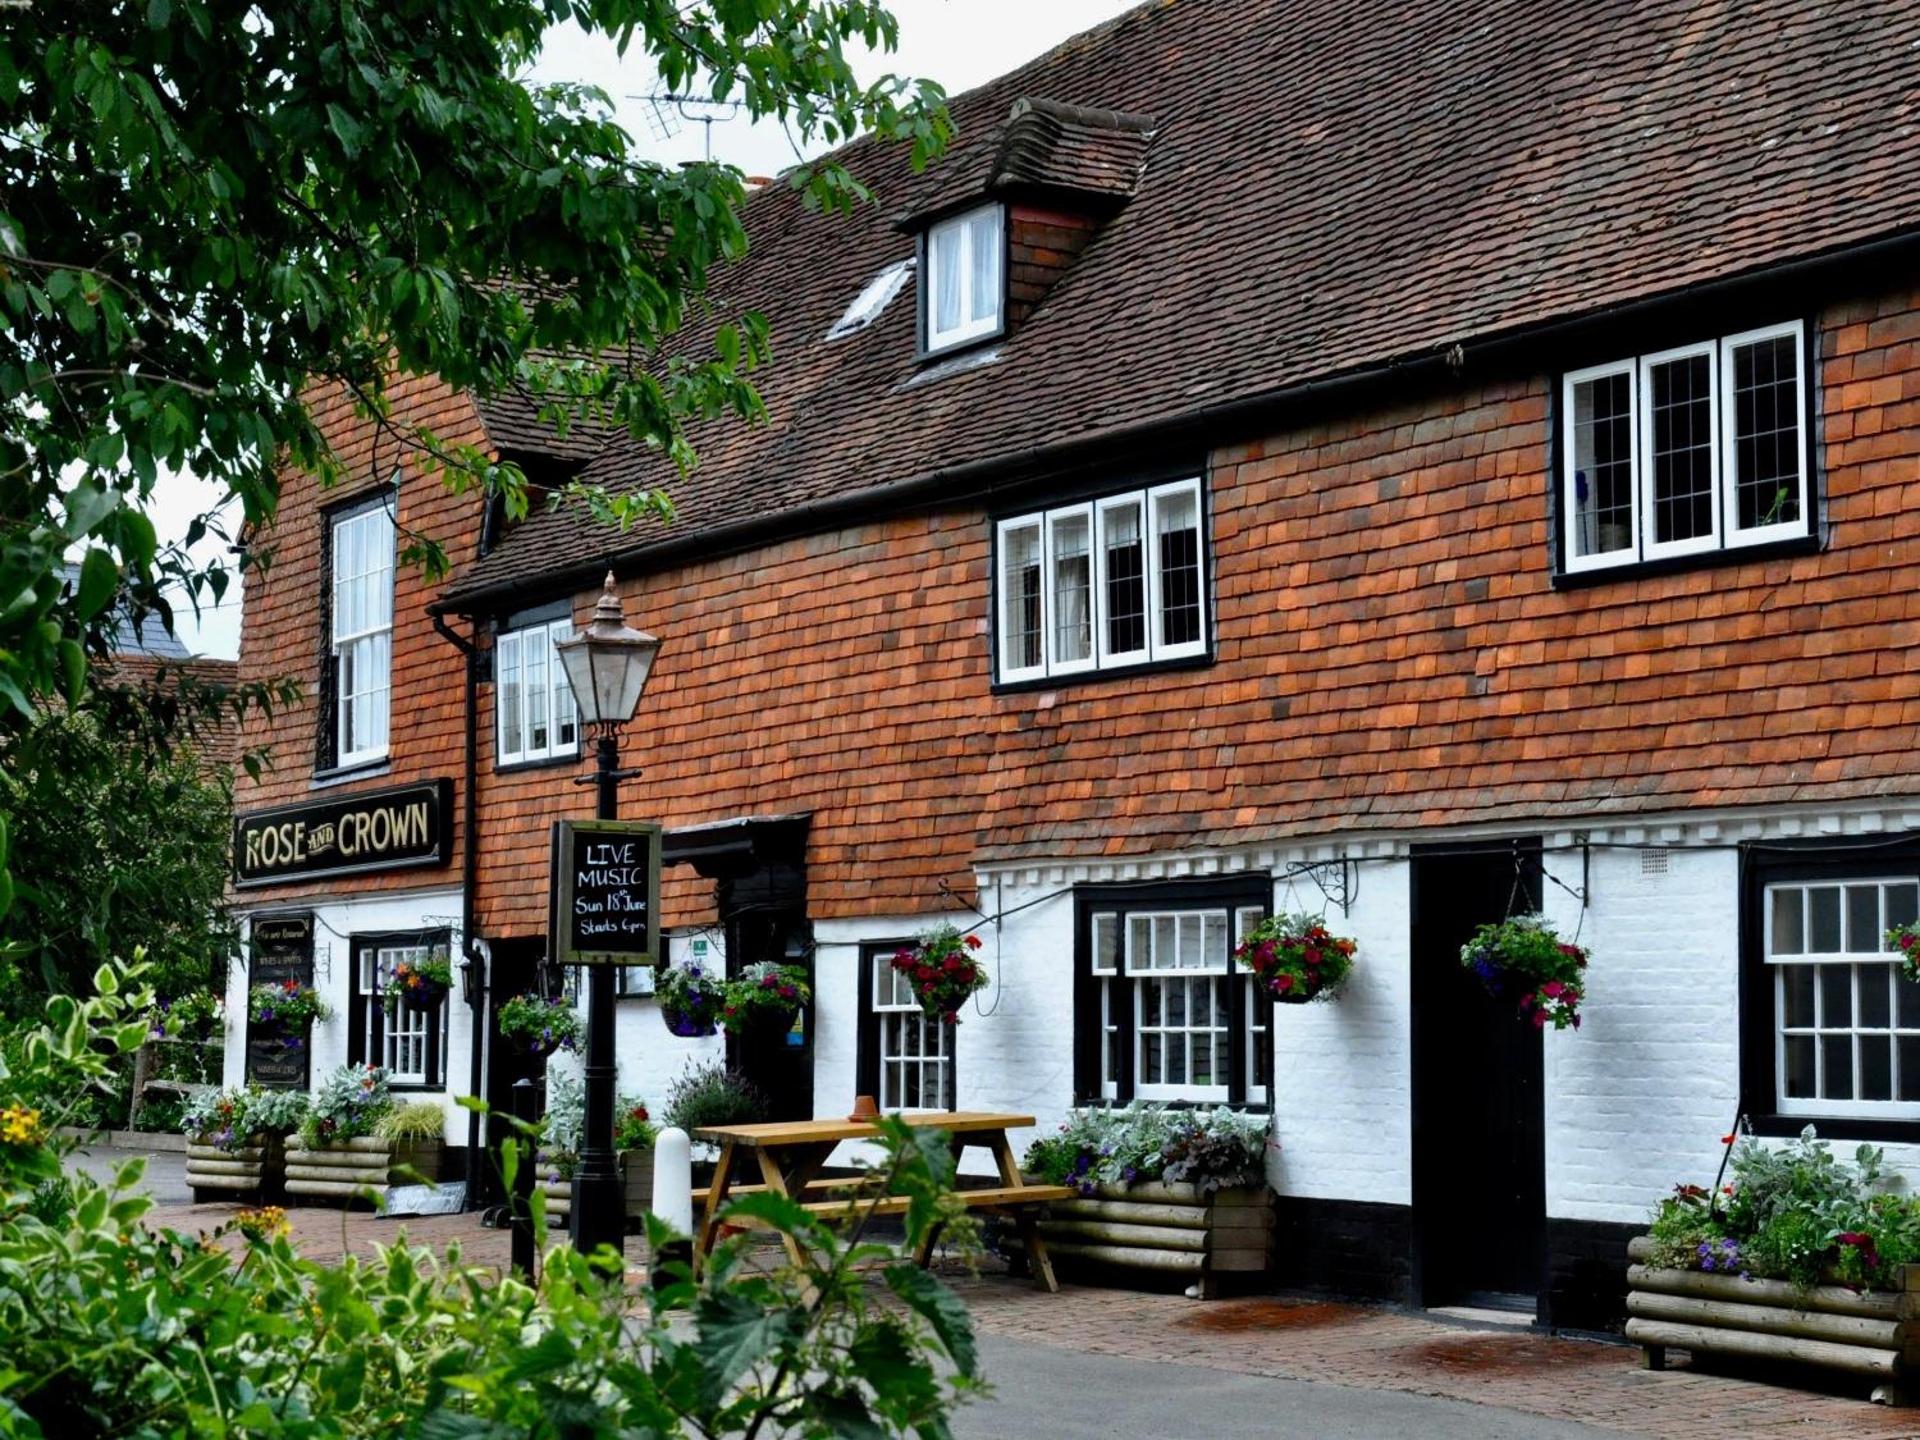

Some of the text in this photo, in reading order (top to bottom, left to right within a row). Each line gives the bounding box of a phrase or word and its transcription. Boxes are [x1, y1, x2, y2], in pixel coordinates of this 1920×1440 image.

[246, 802, 428, 869] ROSE AND CROWN
[587, 843, 636, 865] LIVE
[578, 867, 642, 888] MUSIC
[575, 896, 603, 914] Sun
[623, 895, 647, 911] June
[580, 918, 617, 935] Starts
